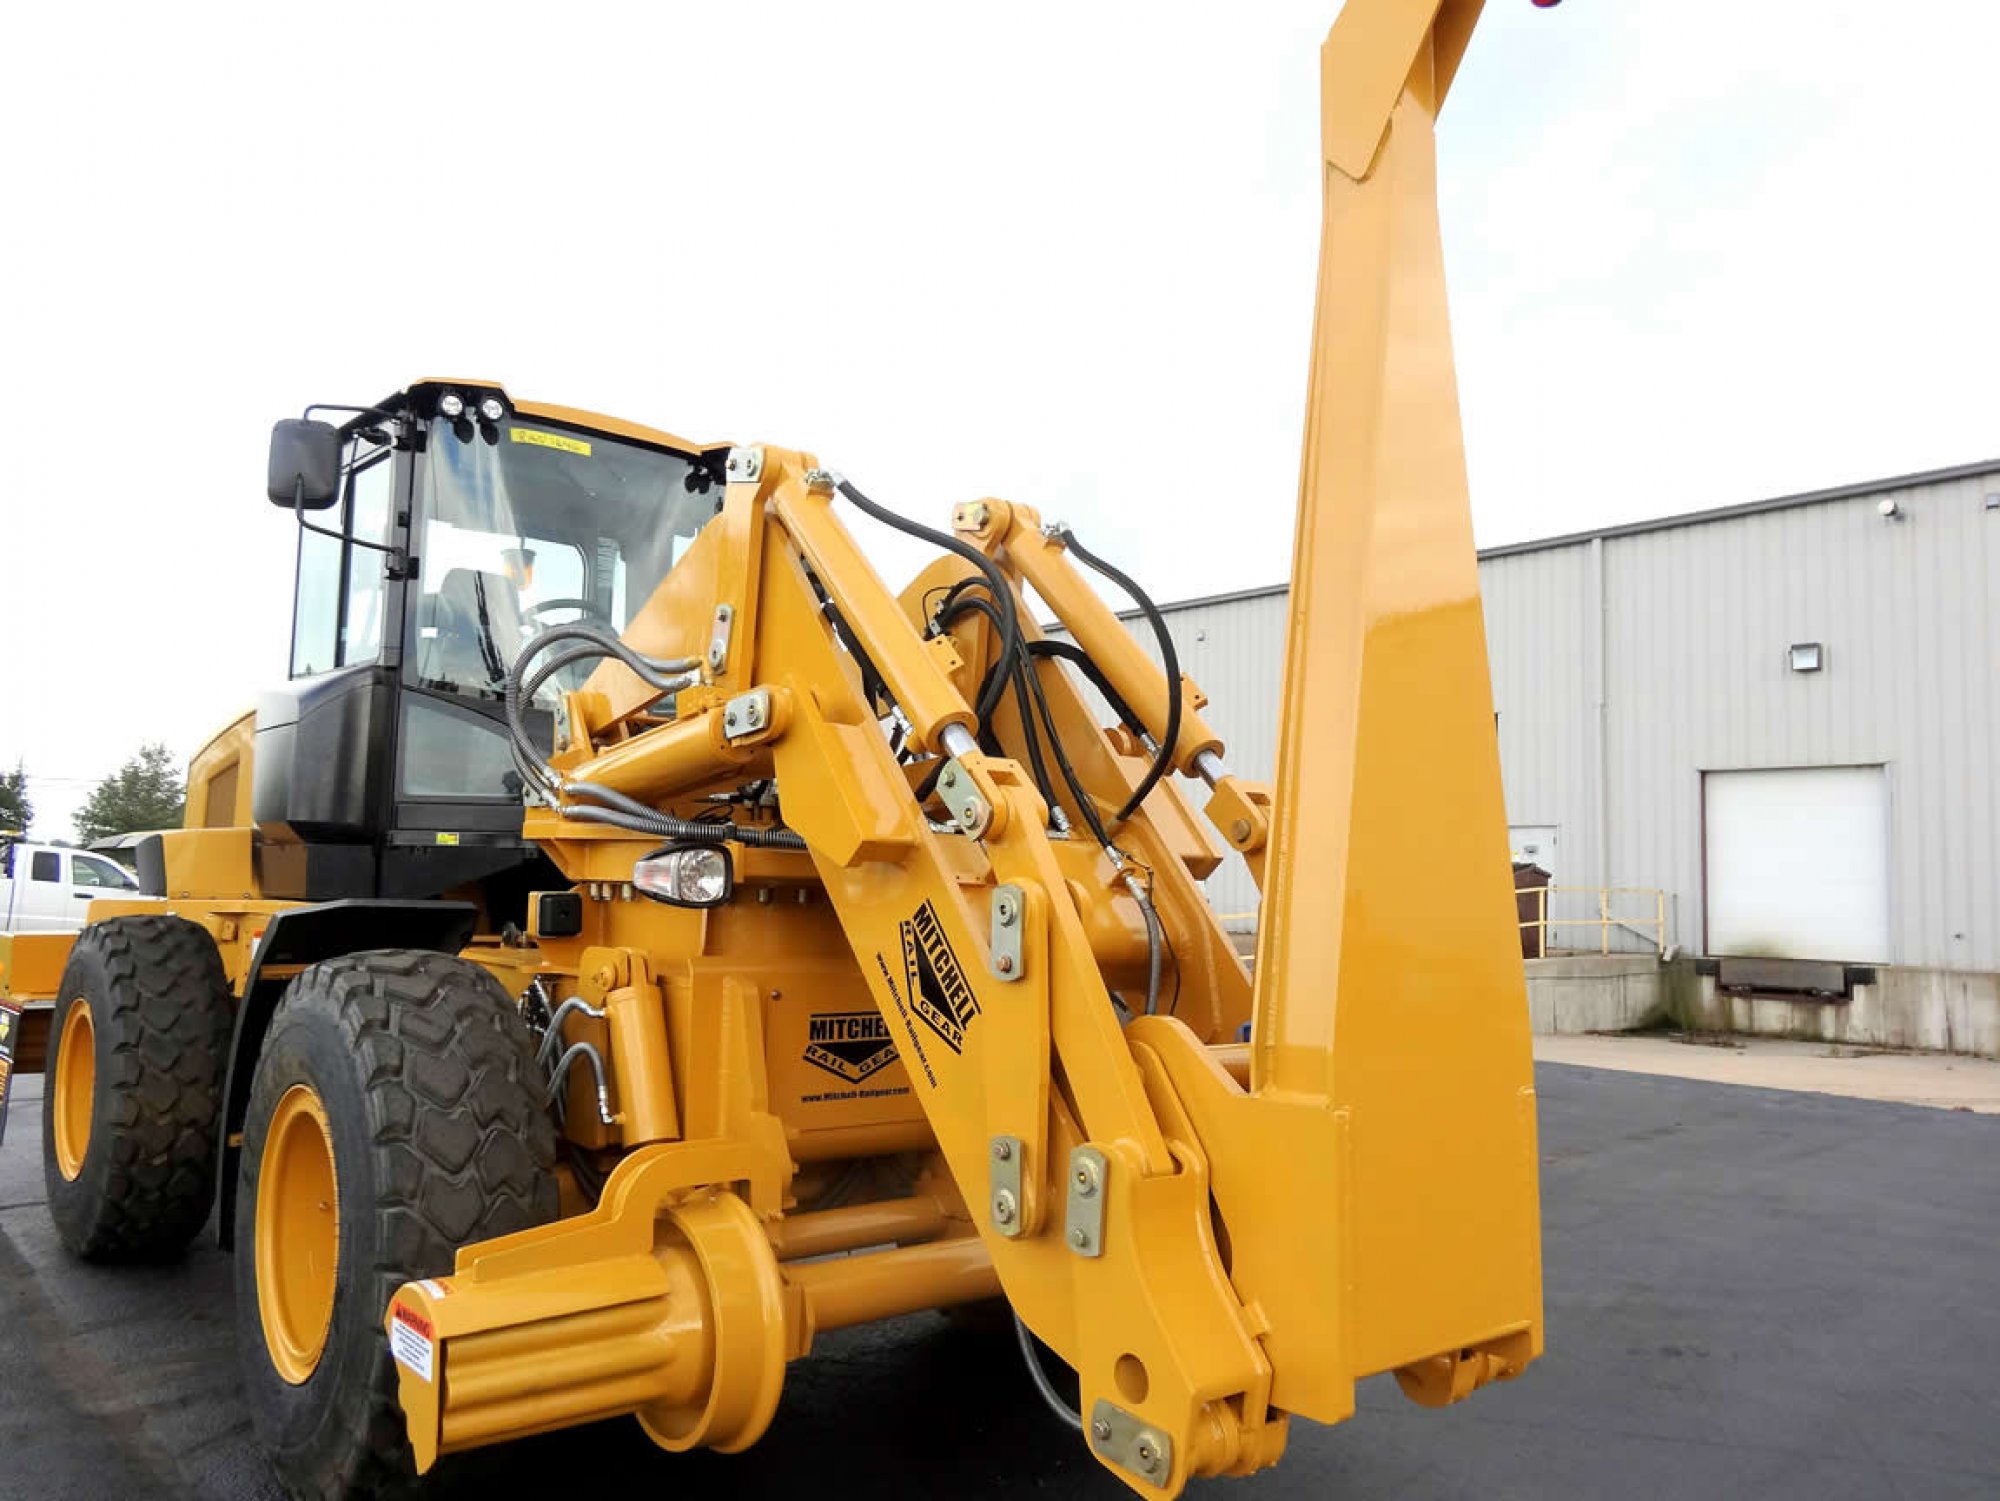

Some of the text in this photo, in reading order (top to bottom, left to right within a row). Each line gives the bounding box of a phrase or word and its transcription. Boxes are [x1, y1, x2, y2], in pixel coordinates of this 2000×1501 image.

[904, 920, 919, 985] RAIL
[913, 903, 976, 1031] MITCHELL
[810, 1018, 891, 1040] MITCHEL
[920, 1000, 964, 1047] GEAR
[805, 1045, 847, 1073] RAIL
[859, 1047, 896, 1073] GEA
